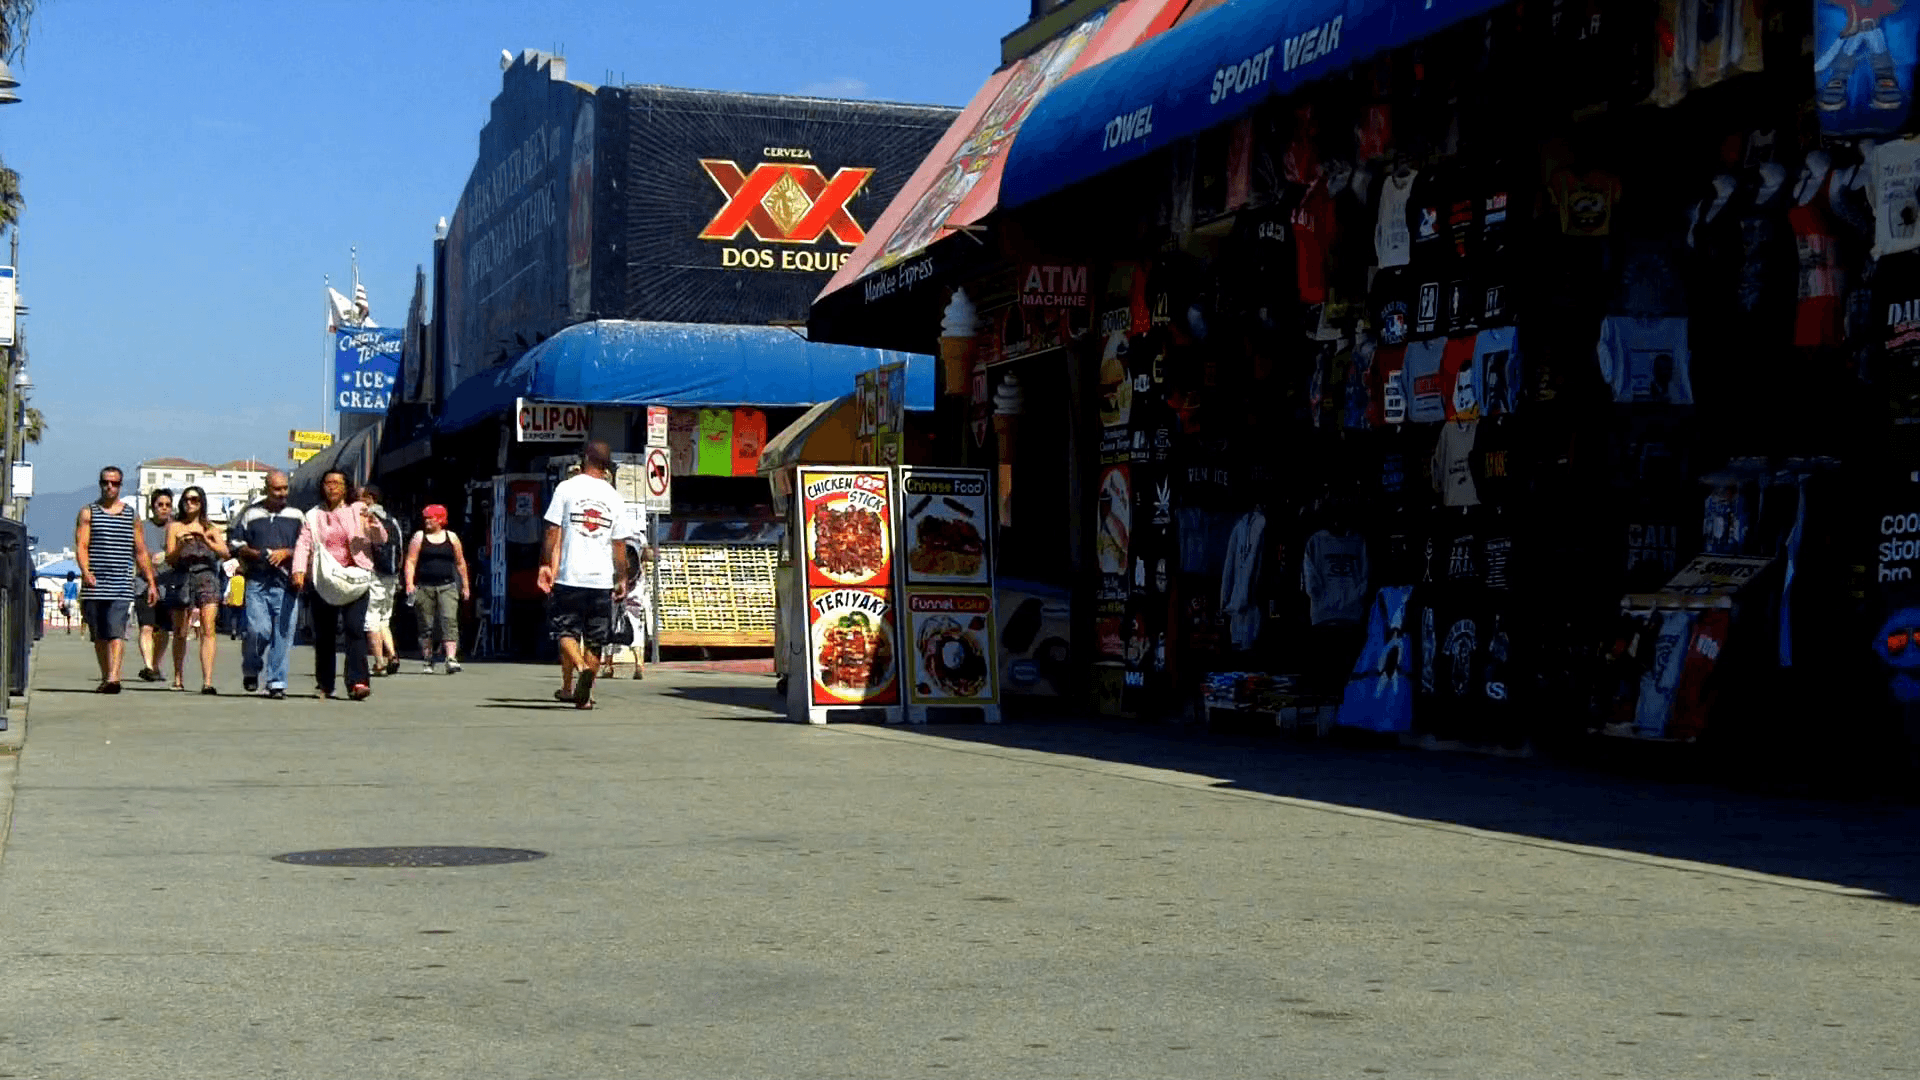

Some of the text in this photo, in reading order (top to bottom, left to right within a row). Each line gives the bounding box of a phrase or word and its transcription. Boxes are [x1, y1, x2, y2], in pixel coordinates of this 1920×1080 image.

[1210, 15, 1343, 105] SPORT WEAR
[1102, 104, 1153, 152] TOWEL
[763, 147, 812, 160] CERVEZA
[722, 248, 775, 269] DOS
[898, 257, 934, 292] Express
[1023, 265, 1088, 294] ATM
[1022, 294, 1087, 307] MACHINE
[354, 370, 385, 388] ICE
[807, 477, 853, 498] CHICKEN
[907, 478, 981, 494] Chinese Food
[849, 491, 883, 511] STICK
[1881, 512, 1920, 536] coo
[815, 591, 889, 617] TERIYAKI
[911, 596, 954, 611] Funnel
